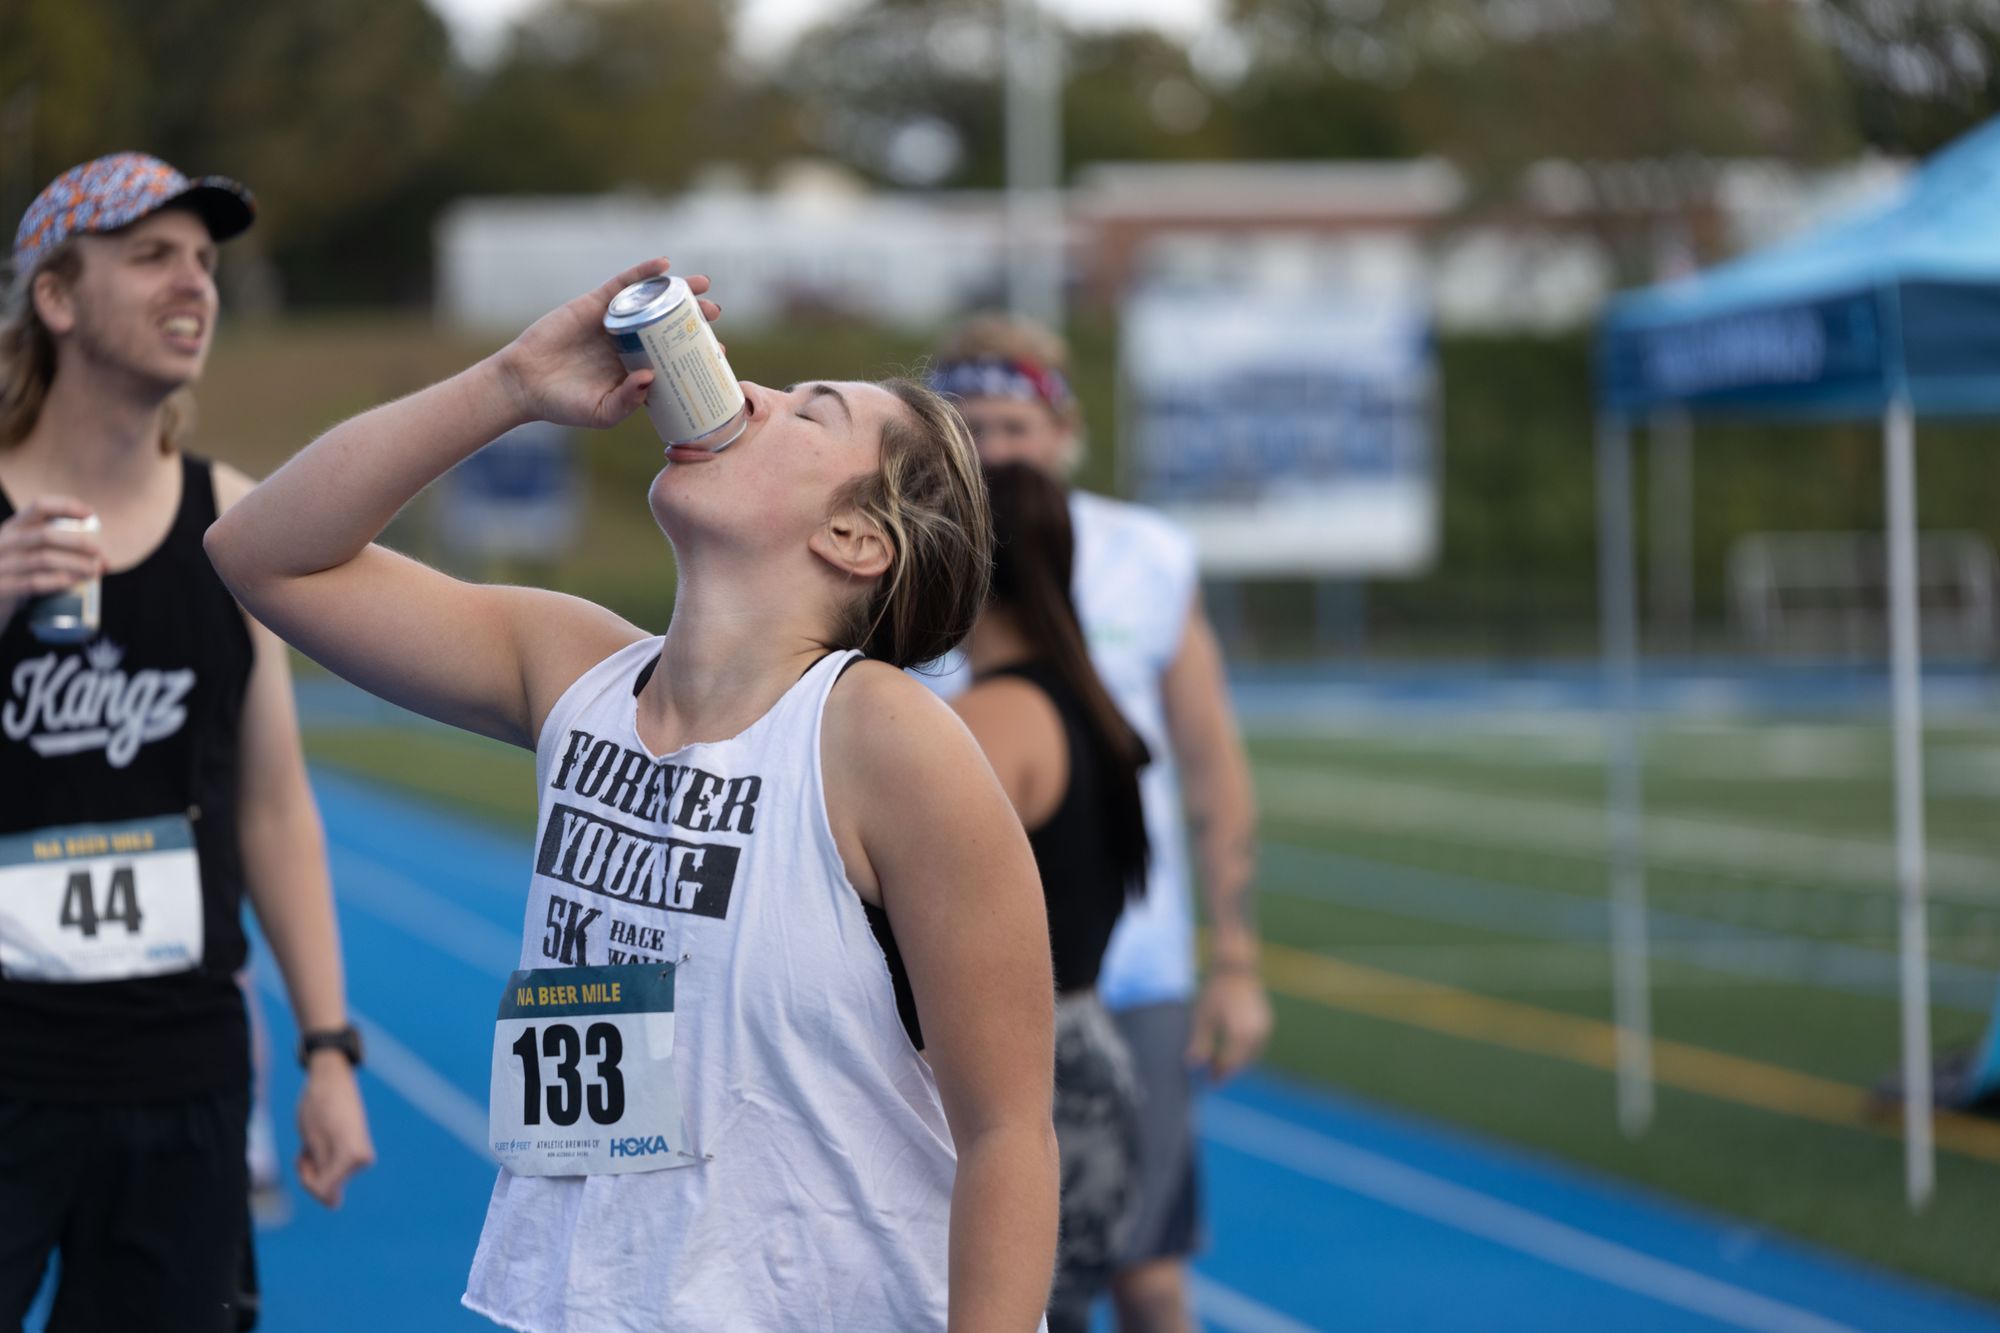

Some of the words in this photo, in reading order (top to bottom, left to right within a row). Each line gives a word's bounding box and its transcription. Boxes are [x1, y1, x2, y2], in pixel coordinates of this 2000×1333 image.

[2, 652, 195, 767] Kangz
[551, 729, 762, 834] FOREVER
[551, 811, 707, 910] YOUNG
[60, 868, 142, 936] 44
[542, 895, 603, 966] 5K
[609, 919, 665, 951] RACE
[517, 986, 535, 1007] NA
[538, 984, 579, 1006] BEER
[582, 982, 622, 1004] MILE
[512, 1022, 626, 1126] 133
[516, 1140, 532, 1150] FEET
[537, 1139, 564, 1149] ATHLETIC
[565, 1139, 591, 1149] BREWING
[610, 1135, 669, 1157] HOKA
